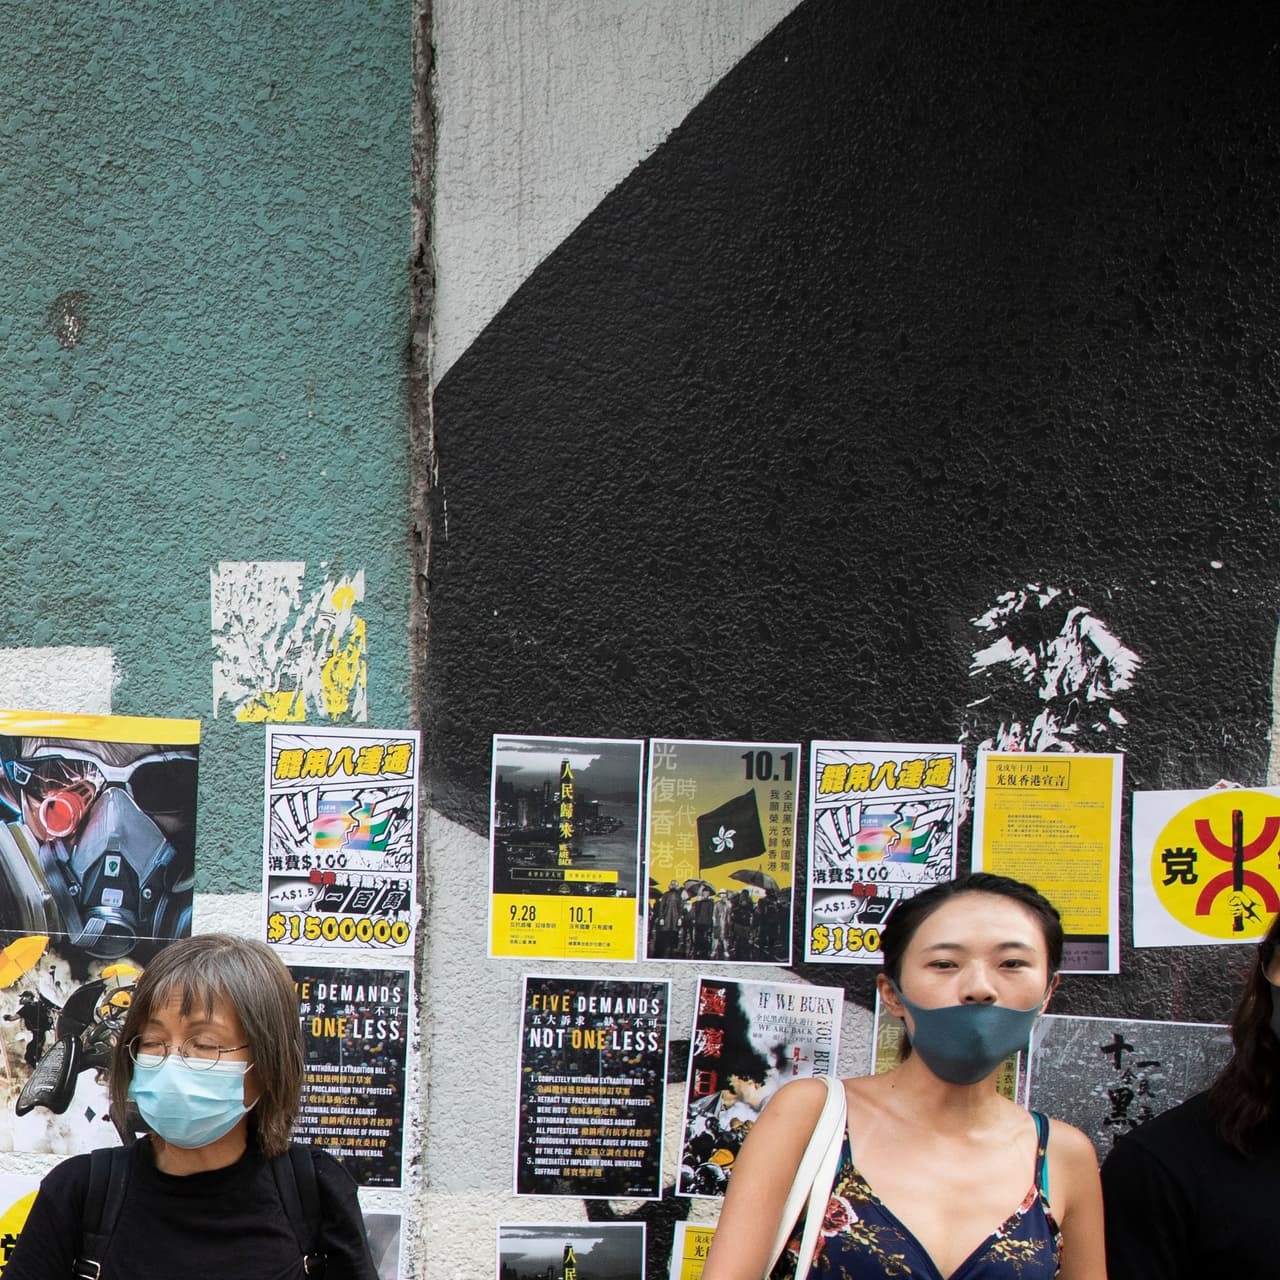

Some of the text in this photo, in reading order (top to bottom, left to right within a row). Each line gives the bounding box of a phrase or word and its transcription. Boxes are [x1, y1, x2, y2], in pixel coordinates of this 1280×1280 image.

[741, 750, 794, 781] 10.1
[996, 774, 1065, 787] 光復香港宣言
[559, 763, 575, 840] 人民歸來
[651, 743, 677, 870] 光復香港
[673, 778, 697, 880] 時代革命
[1161, 847, 1199, 887] 党
[509, 905, 537, 921] 9.28
[569, 907, 594, 923] 10.1
[268, 912, 410, 944] $1500000
[318, 982, 401, 1003] DEMANDS
[758, 991, 835, 1015] IF WE BURN
[531, 994, 660, 1016] FIVE DEMANDS
[311, 1017, 400, 1040] ONE LESS
[532, 1015, 658, 1029] 五大訴求 缺一不可
[529, 1028, 659, 1051] NOT ONE LESS
